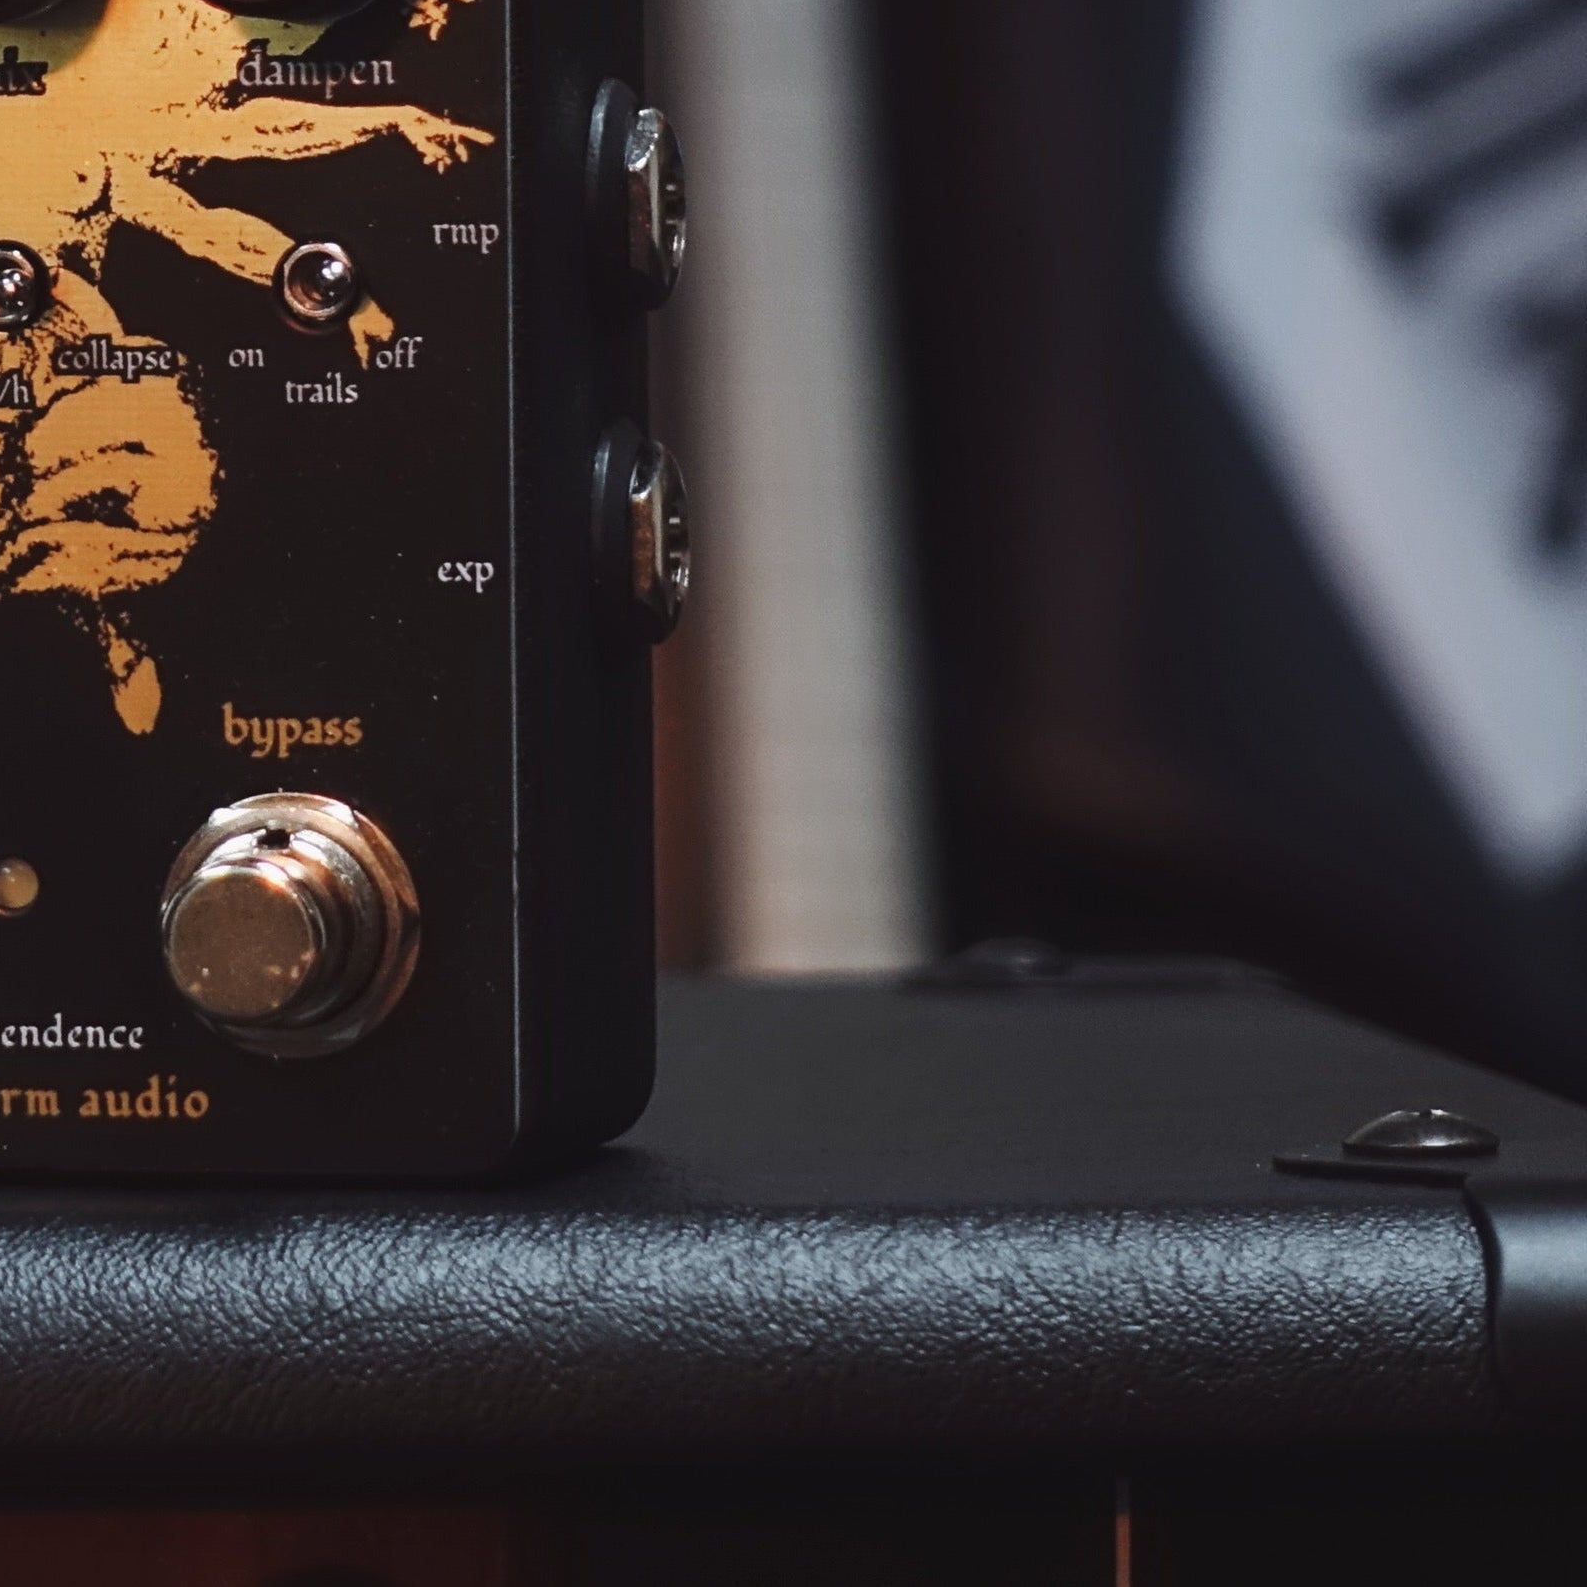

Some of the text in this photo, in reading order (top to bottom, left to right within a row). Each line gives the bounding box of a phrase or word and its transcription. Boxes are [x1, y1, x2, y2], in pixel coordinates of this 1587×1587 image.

[239, 46, 395, 99] dampen
[432, 221, 498, 254] rmp
[58, 340, 173, 379] collapse
[229, 347, 264, 368] on
[374, 337, 422, 370] off
[285, 372, 358, 404] trails
[437, 559, 493, 593] exp
[222, 702, 362, 757] bypass
[79, 1073, 209, 1117] audio
